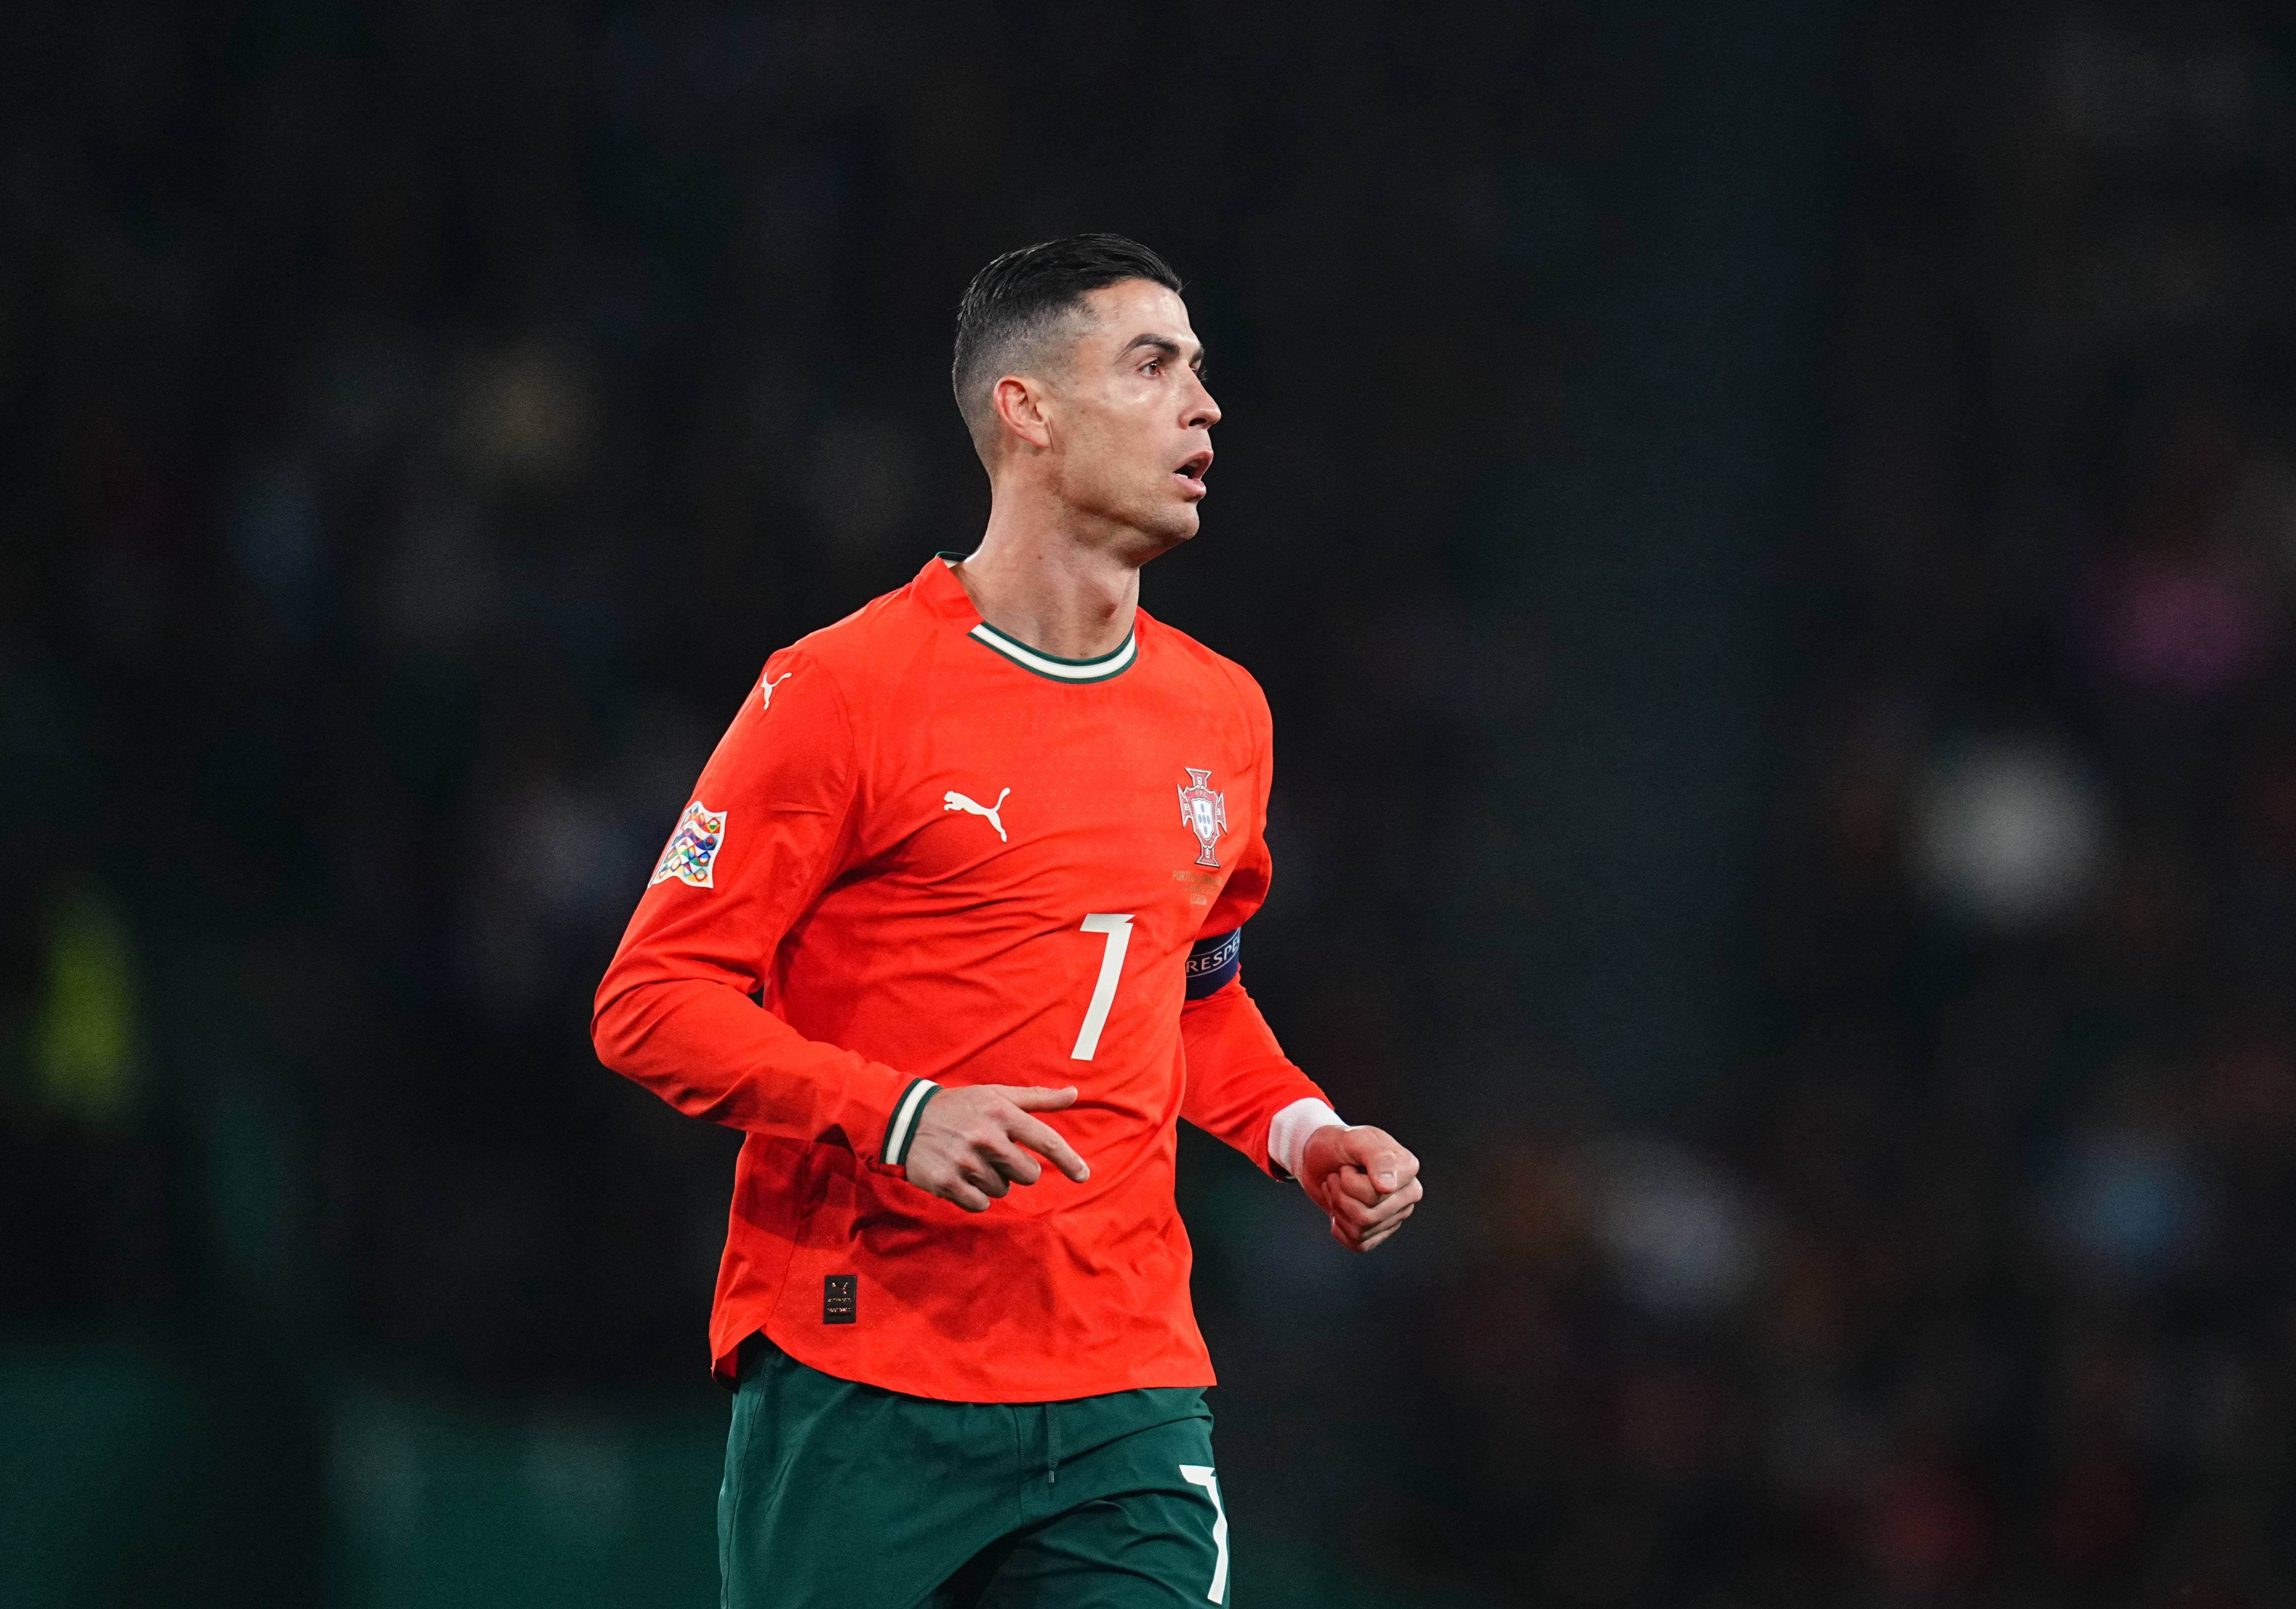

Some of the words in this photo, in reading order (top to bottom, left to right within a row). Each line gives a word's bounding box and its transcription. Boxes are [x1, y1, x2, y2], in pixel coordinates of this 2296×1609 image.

[1190, 894, 1207, 905] LISBOA
[1071, 913, 1135, 1061] 7
[1179, 1465, 1228, 1605] 7
